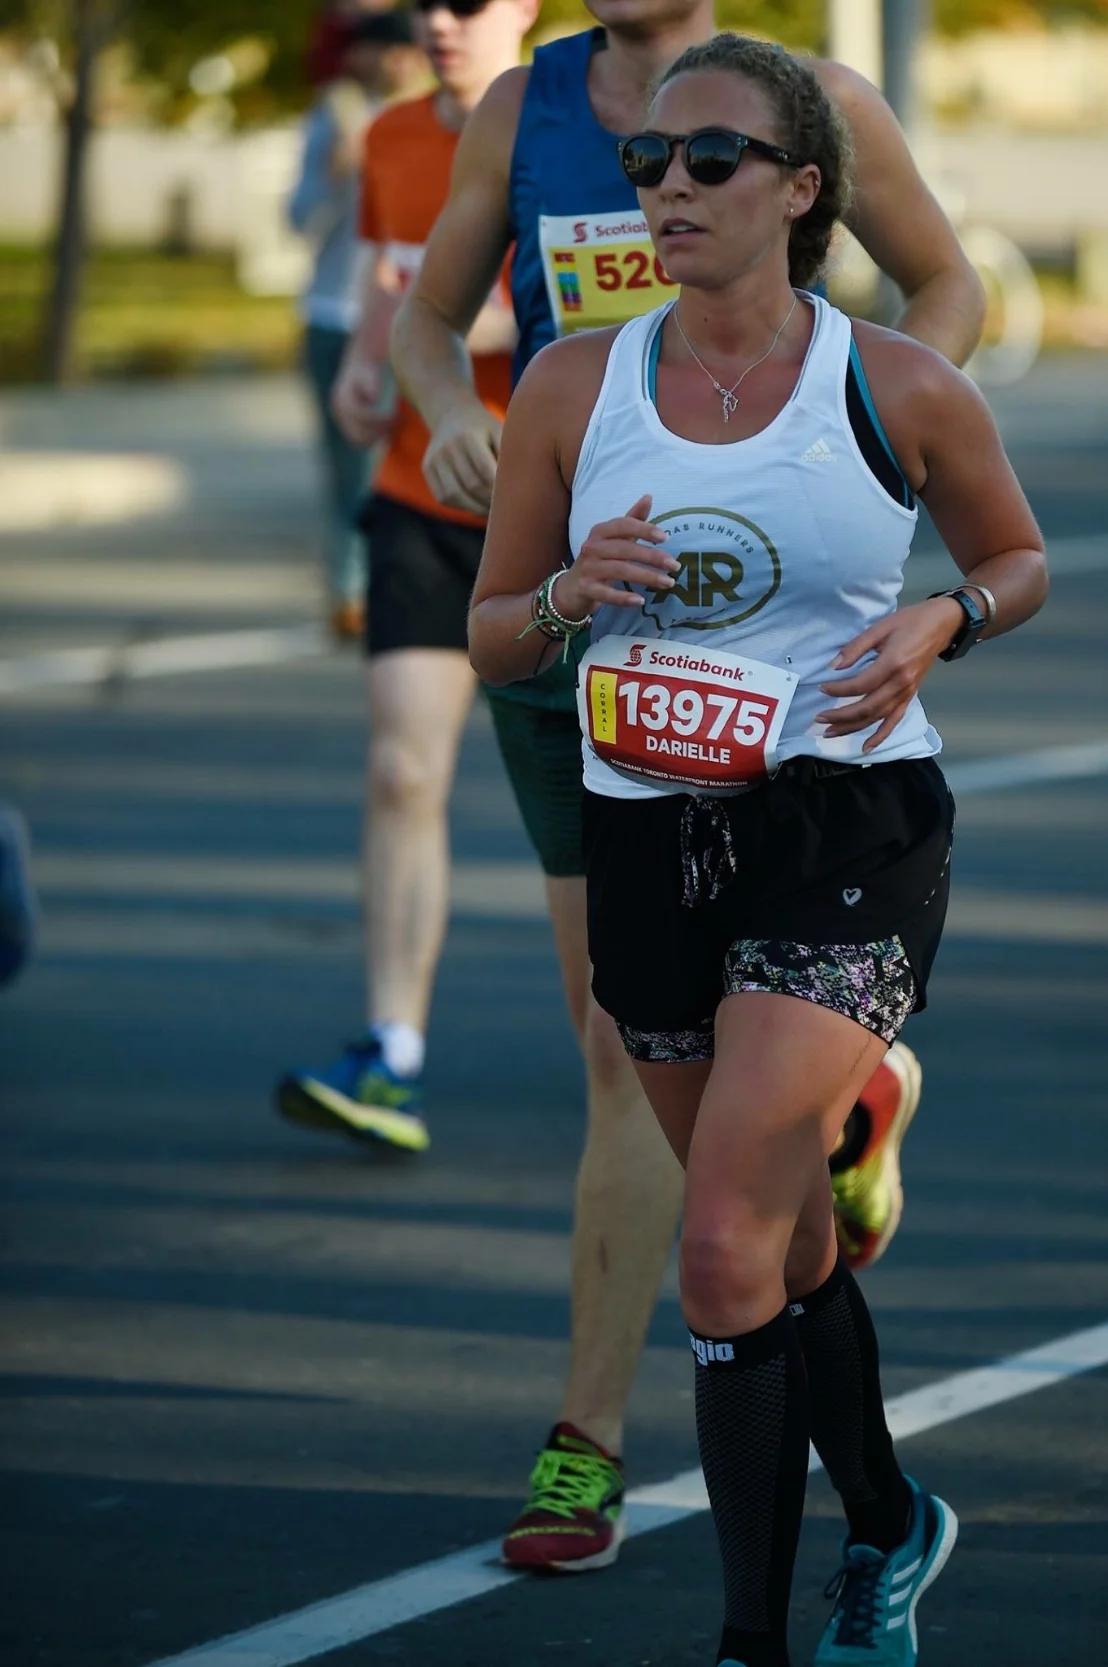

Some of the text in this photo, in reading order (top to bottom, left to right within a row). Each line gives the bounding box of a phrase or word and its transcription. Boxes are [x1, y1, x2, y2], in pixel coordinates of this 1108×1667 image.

[699, 522, 755, 554] RUNNERS
[649, 651, 745, 681] Scotiabank
[600, 683, 608, 732] CORRAL
[618, 681, 770, 747] 13975
[645, 735, 731, 764] DARIELLE
[610, 758, 642, 772] SCOTIABANK
[643, 768, 669, 779] TORONTO
[669, 774, 708, 786] WATERFRONT
